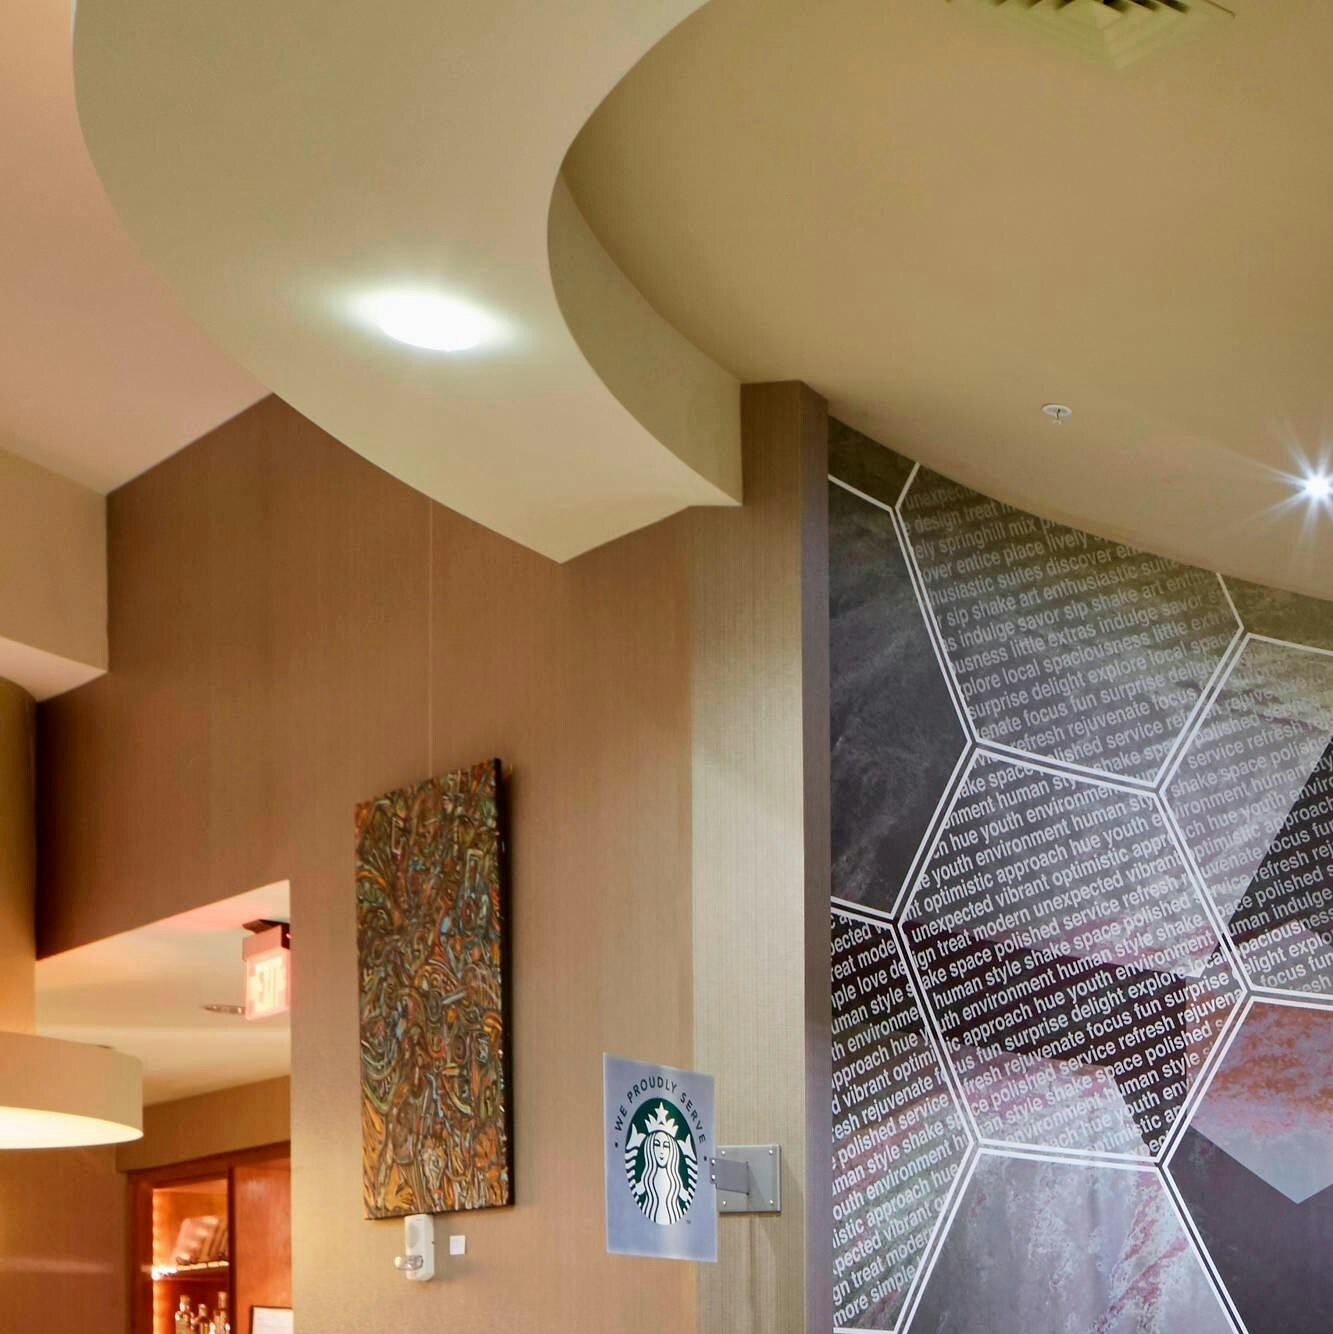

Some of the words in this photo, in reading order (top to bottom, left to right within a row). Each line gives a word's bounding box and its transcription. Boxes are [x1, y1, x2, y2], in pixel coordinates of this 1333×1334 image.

[1004, 656, 1040, 684] local
[1031, 669, 1085, 701] delight
[1023, 701, 1067, 728] focus
[1070, 693, 1097, 714] fun
[1067, 700, 1149, 738] rejuvenate
[1106, 719, 1163, 750] service
[997, 779, 1049, 809] human
[933, 850, 973, 887] youth
[975, 817, 1069, 867] environment
[1072, 800, 1130, 832] human
[951, 828, 977, 851] hue
[980, 808, 1022, 844] youth
[1266, 827, 1309, 855] focus
[924, 870, 993, 912] optimistic
[996, 840, 1067, 884] approach
[1070, 833, 1100, 856] hue
[1103, 812, 1148, 848] youth
[1253, 846, 1308, 882] refresh
[1254, 863, 1323, 907] polished
[912, 892, 993, 942] unexpected
[996, 872, 1049, 908] vibrant
[1052, 845, 1128, 887] optimistic
[936, 927, 970, 958] treat
[973, 907, 1030, 942] modern
[1033, 868, 1123, 918] unexpected
[1126, 847, 1180, 883] vibrant
[1272, 885, 1332, 920] indulge
[950, 947, 992, 978] space
[994, 915, 1060, 962] polished
[1063, 897, 1119, 931] service
[1122, 871, 1176, 908] refresh
[858, 965, 887, 992] love
[932, 976, 982, 1010] human
[985, 958, 1021, 987] style
[1024, 939, 1070, 971] shake
[1073, 920, 1120, 951] space
[962, 966, 1055, 1022] environment
[1058, 947, 1112, 981] human
[1115, 929, 1153, 957] style
[964, 999, 1032, 1047] approach
[1035, 990, 1064, 1015] hue
[1067, 965, 1112, 1004] youth
[1115, 926, 1212, 980] environment
[1260, 961, 1305, 991] focus
[870, 983, 903, 1013] style
[976, 1042, 1002, 1067] fun
[1004, 1012, 1068, 1053] surprise
[1071, 984, 1124, 1023] delight
[1127, 963, 1185, 999] explore
[1010, 1029, 1084, 1075] rejuvenate
[1087, 1009, 1131, 1040] focus
[1134, 996, 1161, 1020] fun
[1164, 969, 1228, 1007] surprise
[889, 1030, 918, 1056] hue
[990, 1061, 1056, 1113] polished
[1058, 1039, 1115, 1076] service
[1118, 1010, 1174, 1050] refresh
[1095, 1051, 1142, 1083] space
[1145, 1017, 1211, 1065] polished
[1161, 1048, 1198, 1077] style
[842, 1065, 890, 1107] vibrant
[862, 1074, 932, 1124] rejuvenate
[614, 1105, 628, 1133] WE
[626, 1076, 678, 1103] PROUDLY
[680, 1091, 706, 1145] SERVE
[838, 1114, 896, 1167] polished
[898, 1092, 948, 1130] service
[866, 1142, 899, 1174] style
[902, 1119, 943, 1154] shake
[866, 1137, 951, 1200] environment
[866, 1174, 929, 1227] approach
[932, 1163, 958, 1190] hue
[882, 1198, 933, 1244] vibrant
[832, 1293, 868, 1328] more
[870, 1263, 916, 1304] simple
[850, 1252, 884, 1291] treat
